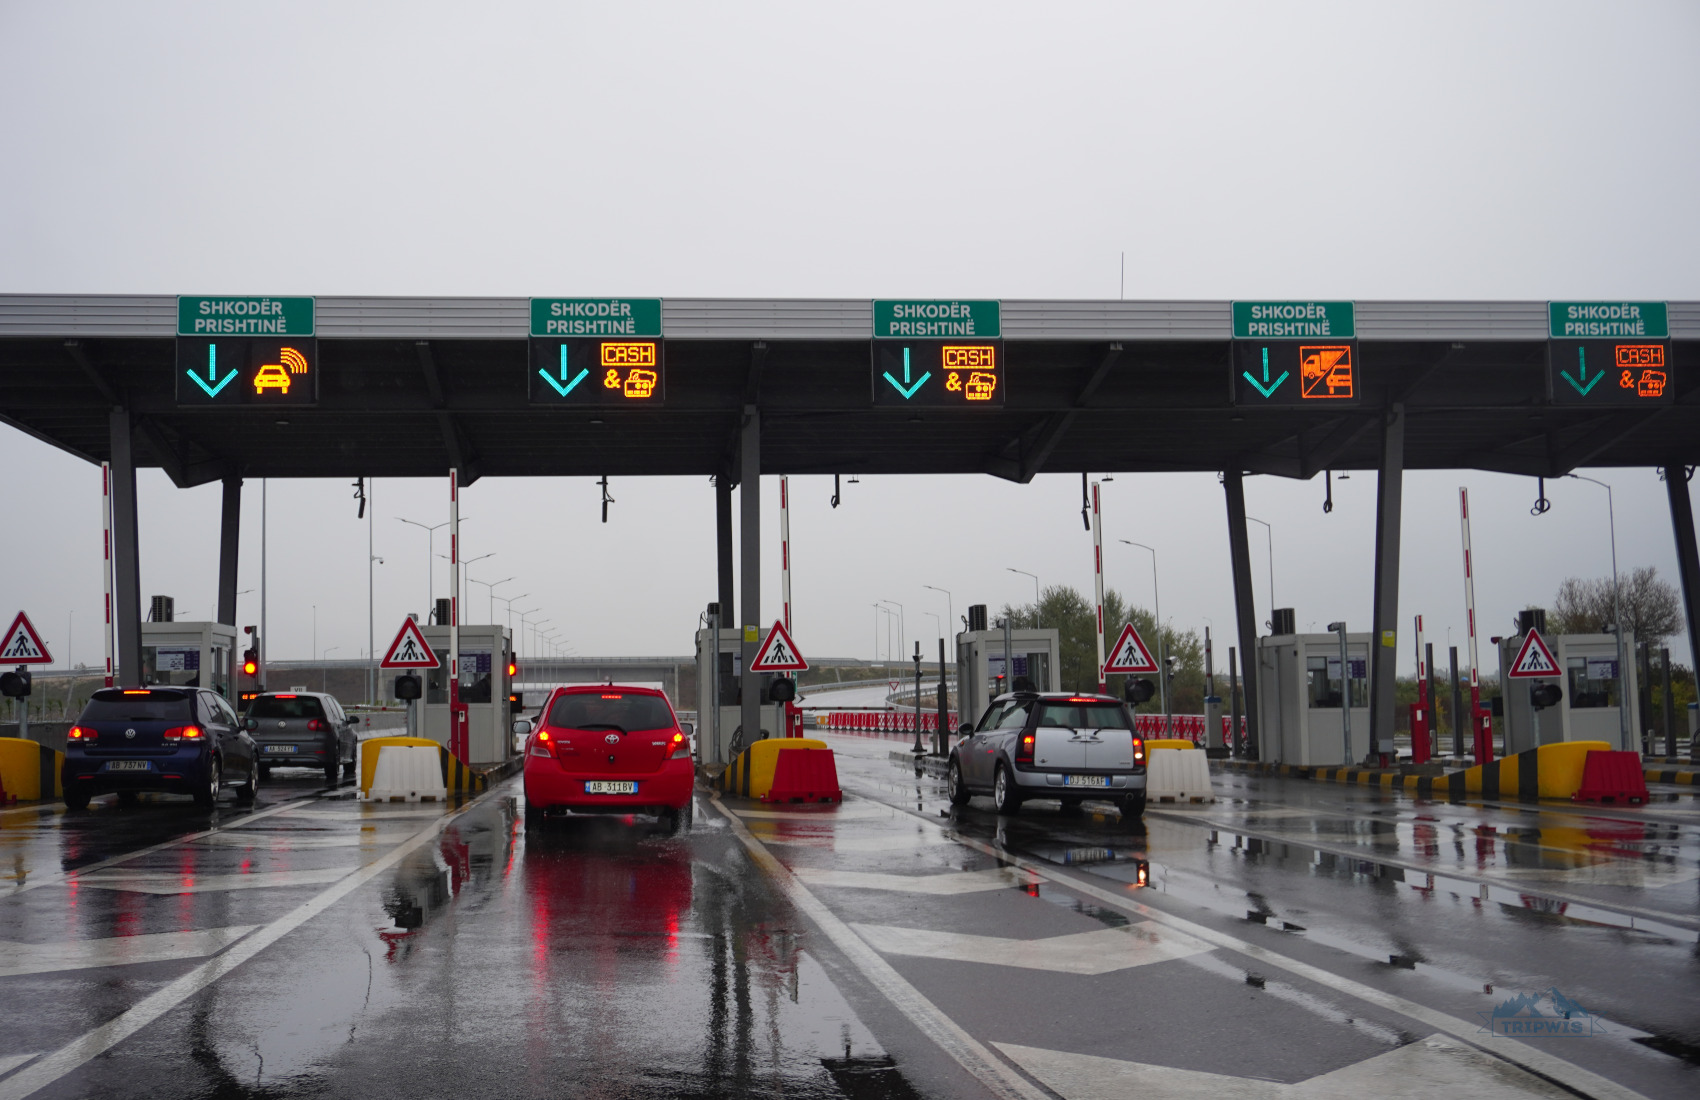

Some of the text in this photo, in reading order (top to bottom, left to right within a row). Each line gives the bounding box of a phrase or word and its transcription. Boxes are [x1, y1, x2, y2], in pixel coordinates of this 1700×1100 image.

[199, 298, 282, 315] SHKODËR
[551, 300, 631, 316] SHKODËR
[893, 302, 971, 318] SHKODËR
[1251, 303, 1326, 319] SHKODËR
[1567, 303, 1641, 319] SHKODËR
[195, 316, 287, 333] PRISHTINË
[547, 317, 636, 334] PRISHTINË
[890, 319, 975, 335] PRISHTINË
[1248, 319, 1331, 336] PRISHTINË
[1565, 319, 1645, 336] PRISHTINË
[605, 346, 651, 362] CASH
[946, 350, 991, 366] CASH
[1619, 348, 1661, 364] CASH
[604, 368, 621, 389] &
[945, 371, 962, 391] &
[1619, 369, 1635, 389] &
